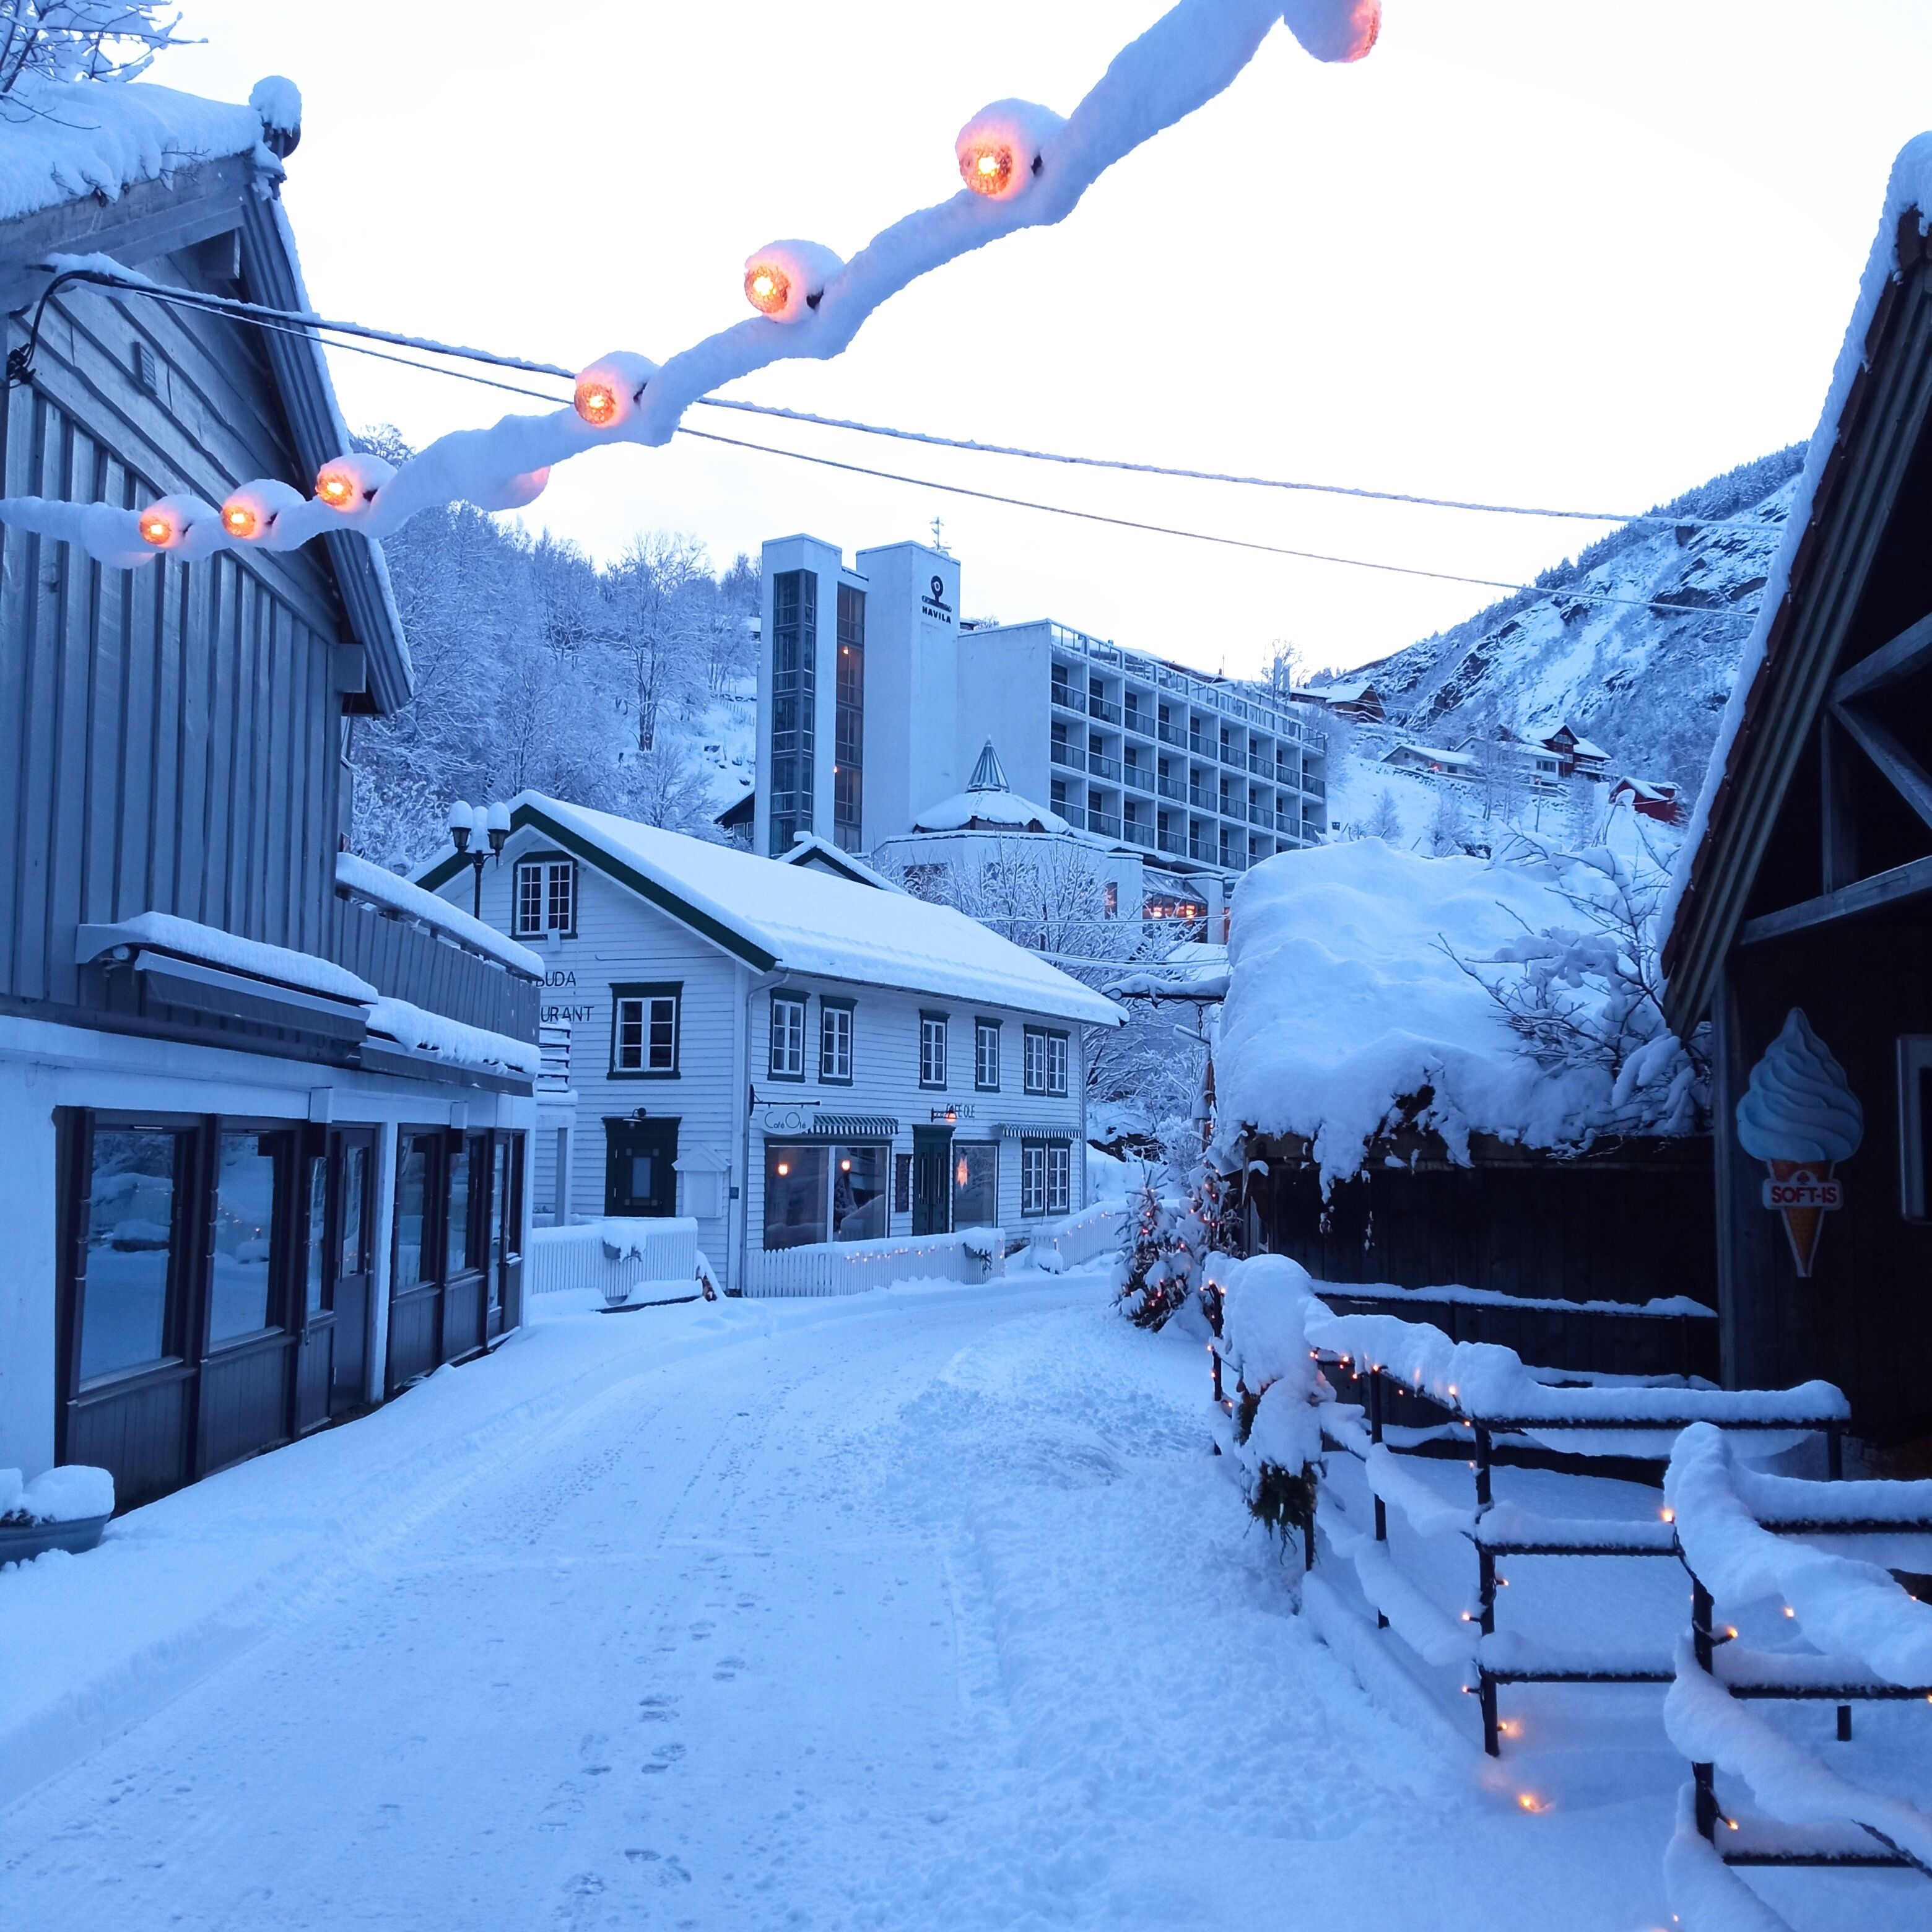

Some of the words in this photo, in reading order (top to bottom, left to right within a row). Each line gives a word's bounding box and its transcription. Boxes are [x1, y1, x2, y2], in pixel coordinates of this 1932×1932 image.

[922, 606, 951, 624] HAVILA
[765, 1112, 785, 1128] Café
[785, 1112, 806, 1128] Olé
[1772, 1186, 1837, 1203] SOFT-IS
